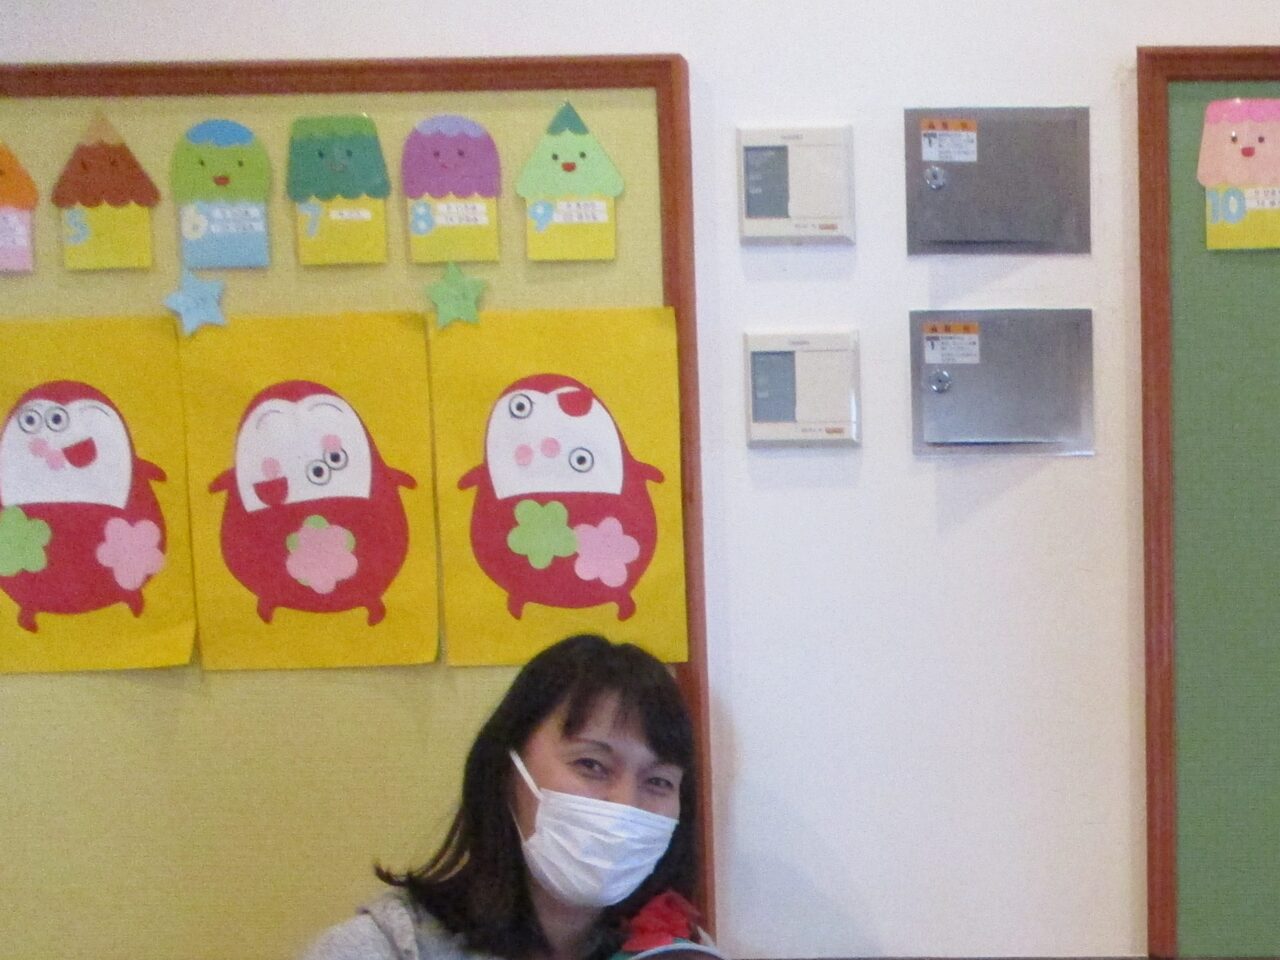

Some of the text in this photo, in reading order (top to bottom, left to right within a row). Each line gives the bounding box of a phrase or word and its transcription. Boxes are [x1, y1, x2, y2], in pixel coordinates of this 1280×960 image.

[181, 203, 208, 240] 6
[298, 201, 321, 237] 7
[411, 202, 435, 235] 8
[528, 202, 553, 232] 9
[1208, 188, 1246, 224] 10
[65, 207, 92, 245] 5
